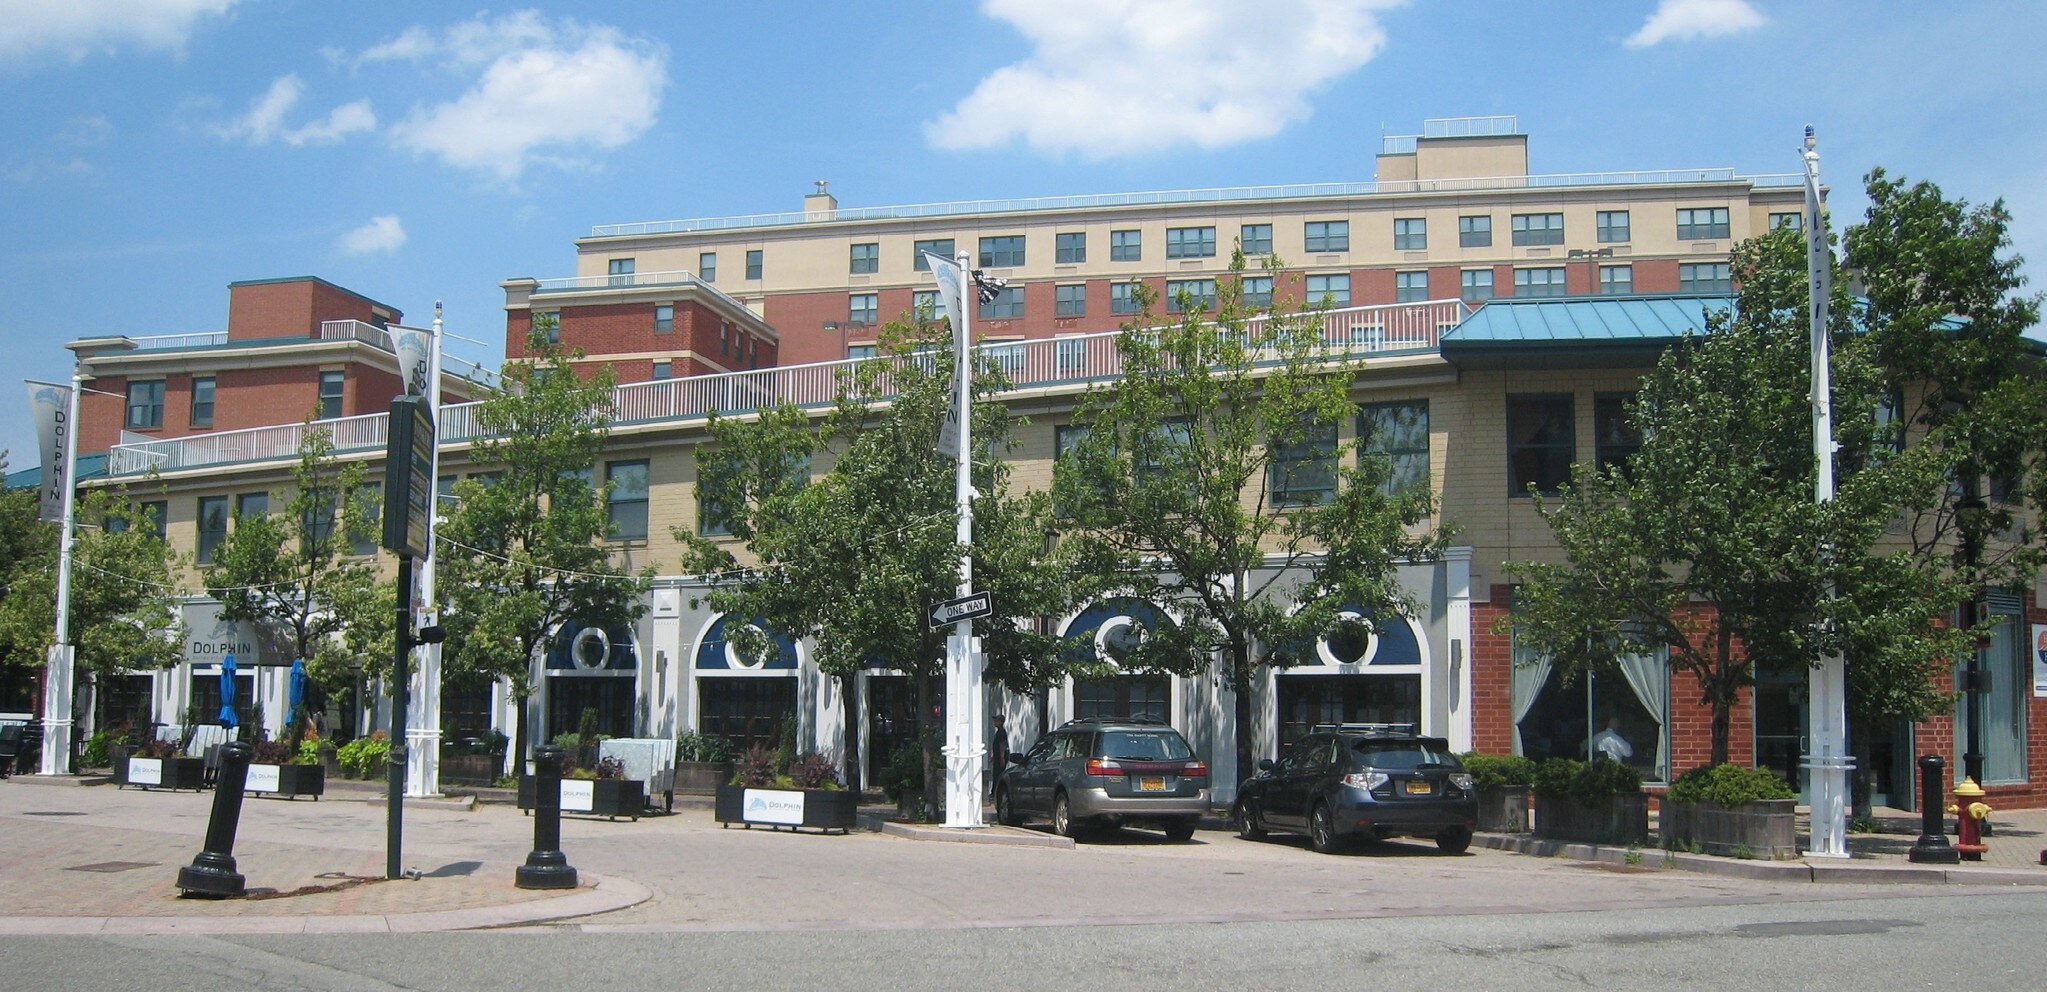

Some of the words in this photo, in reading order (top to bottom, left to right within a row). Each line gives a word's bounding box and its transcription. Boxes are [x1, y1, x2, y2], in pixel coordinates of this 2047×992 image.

[50, 410, 66, 500] DOLPHIN
[947, 604, 964, 617] ONE
[966, 600, 983, 612] WAY
[193, 641, 251, 654] DOLPHIN
[769, 801, 801, 810] DOLPHIN
